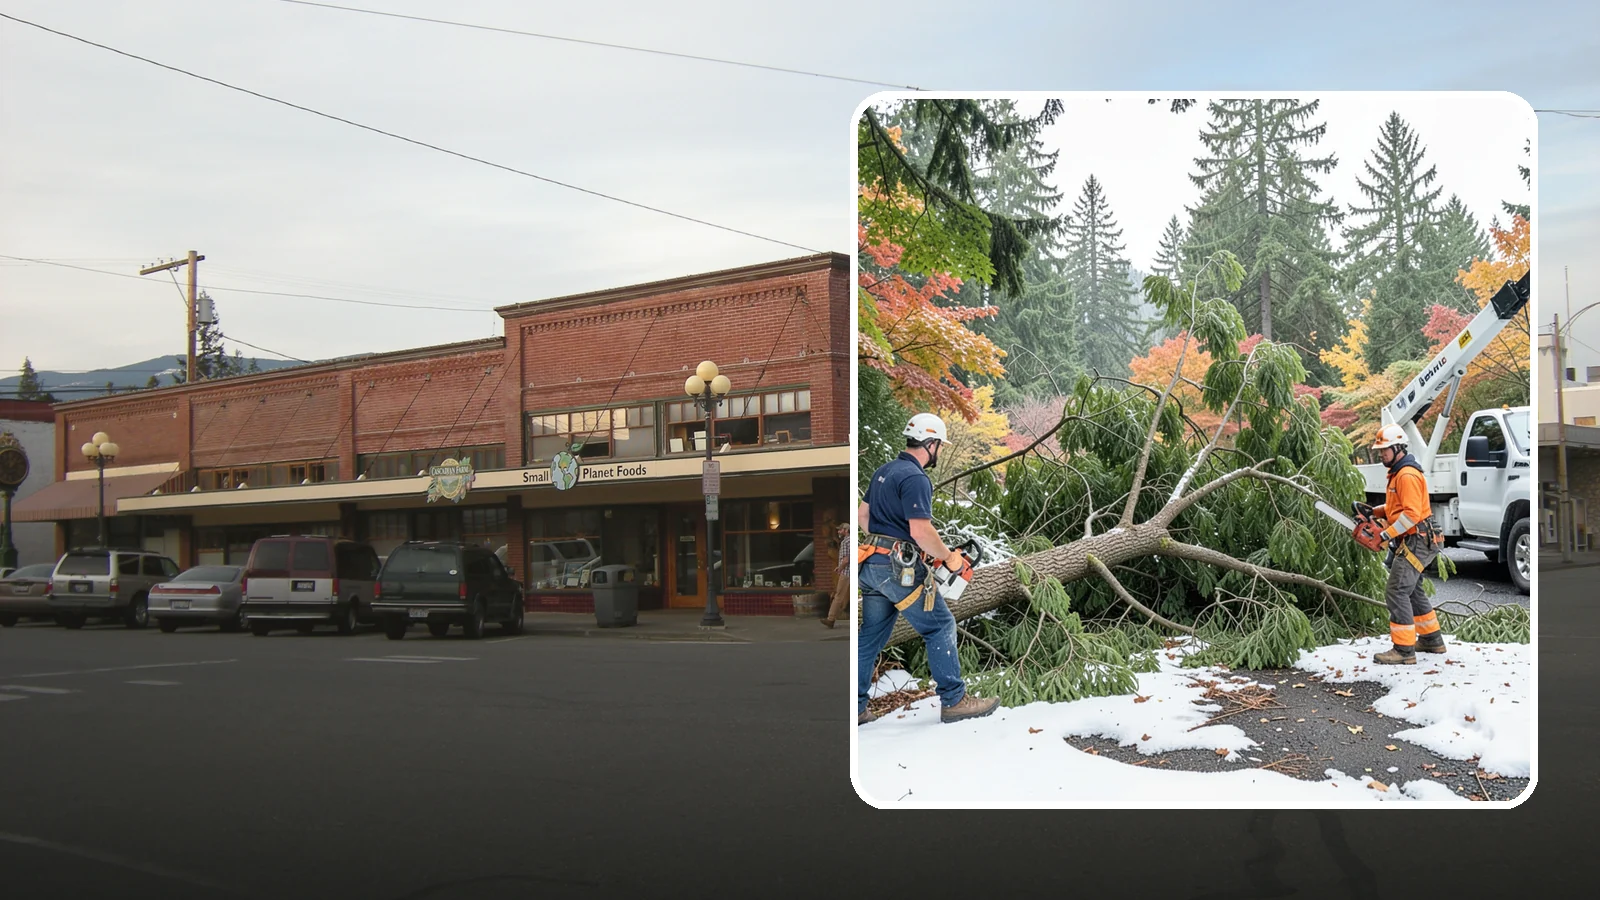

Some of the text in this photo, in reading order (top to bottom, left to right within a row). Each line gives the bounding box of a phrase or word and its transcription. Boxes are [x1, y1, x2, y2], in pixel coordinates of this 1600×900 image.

[523, 464, 647, 483] Small Planet Foods
